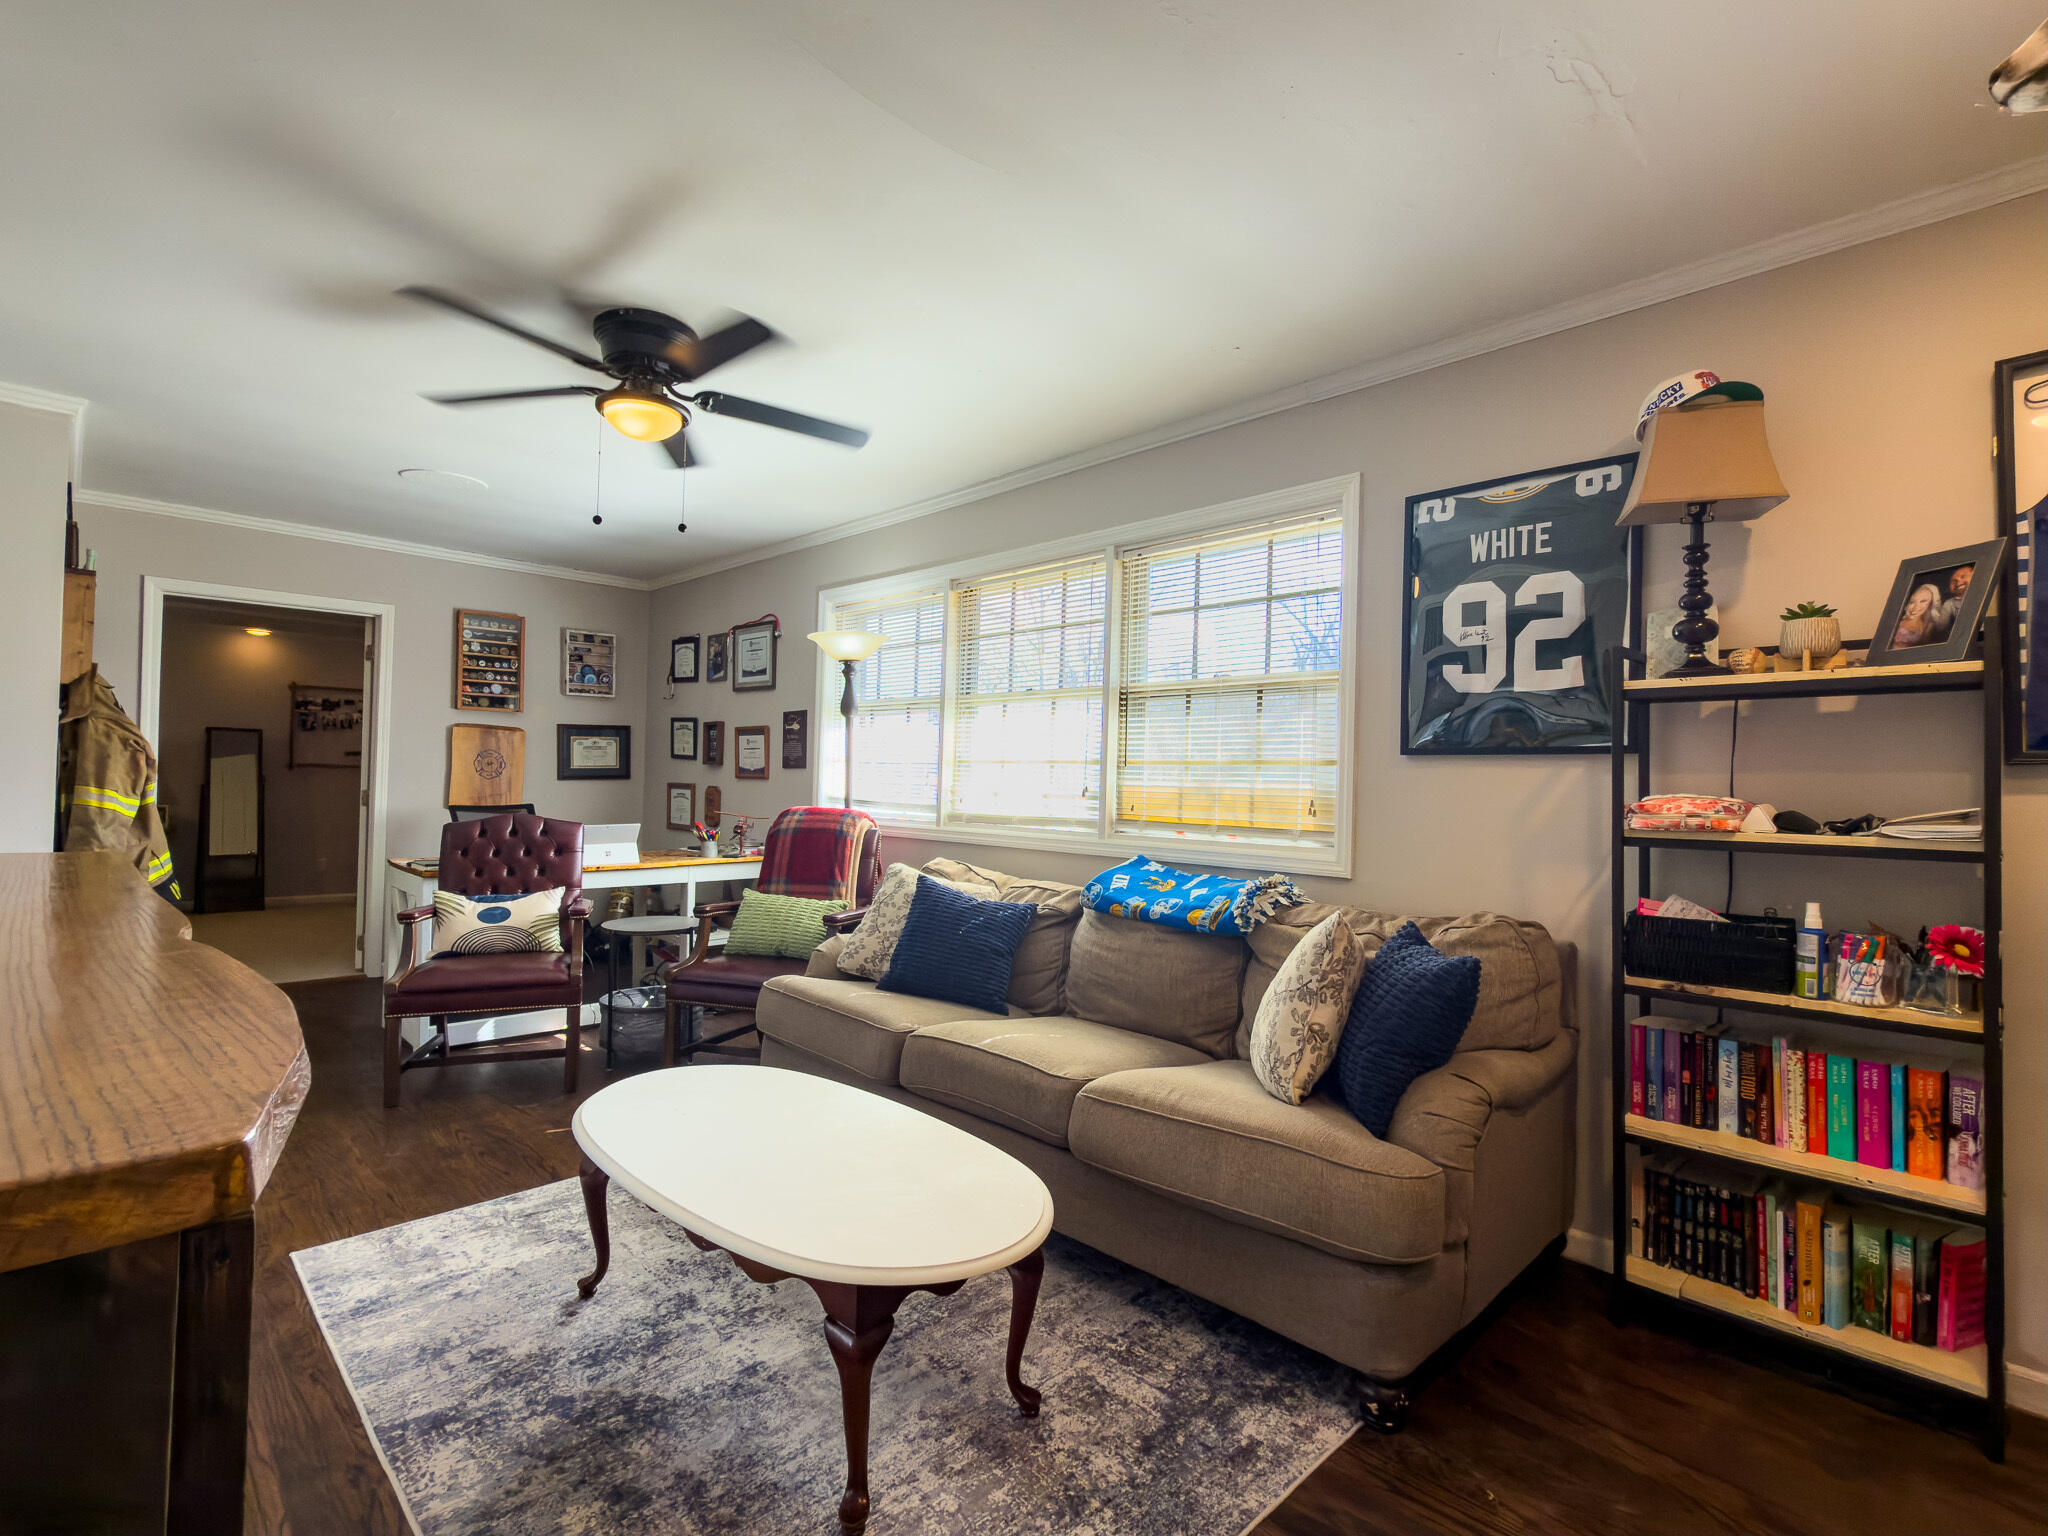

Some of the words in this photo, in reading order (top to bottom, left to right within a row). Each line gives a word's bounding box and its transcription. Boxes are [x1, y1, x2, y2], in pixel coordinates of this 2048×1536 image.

[1470, 521, 1553, 564] WHITE
[1442, 570, 1586, 694] 92
[1952, 1096, 1962, 1125] COLLIDED
[1962, 1087, 1977, 1116] AFTER
